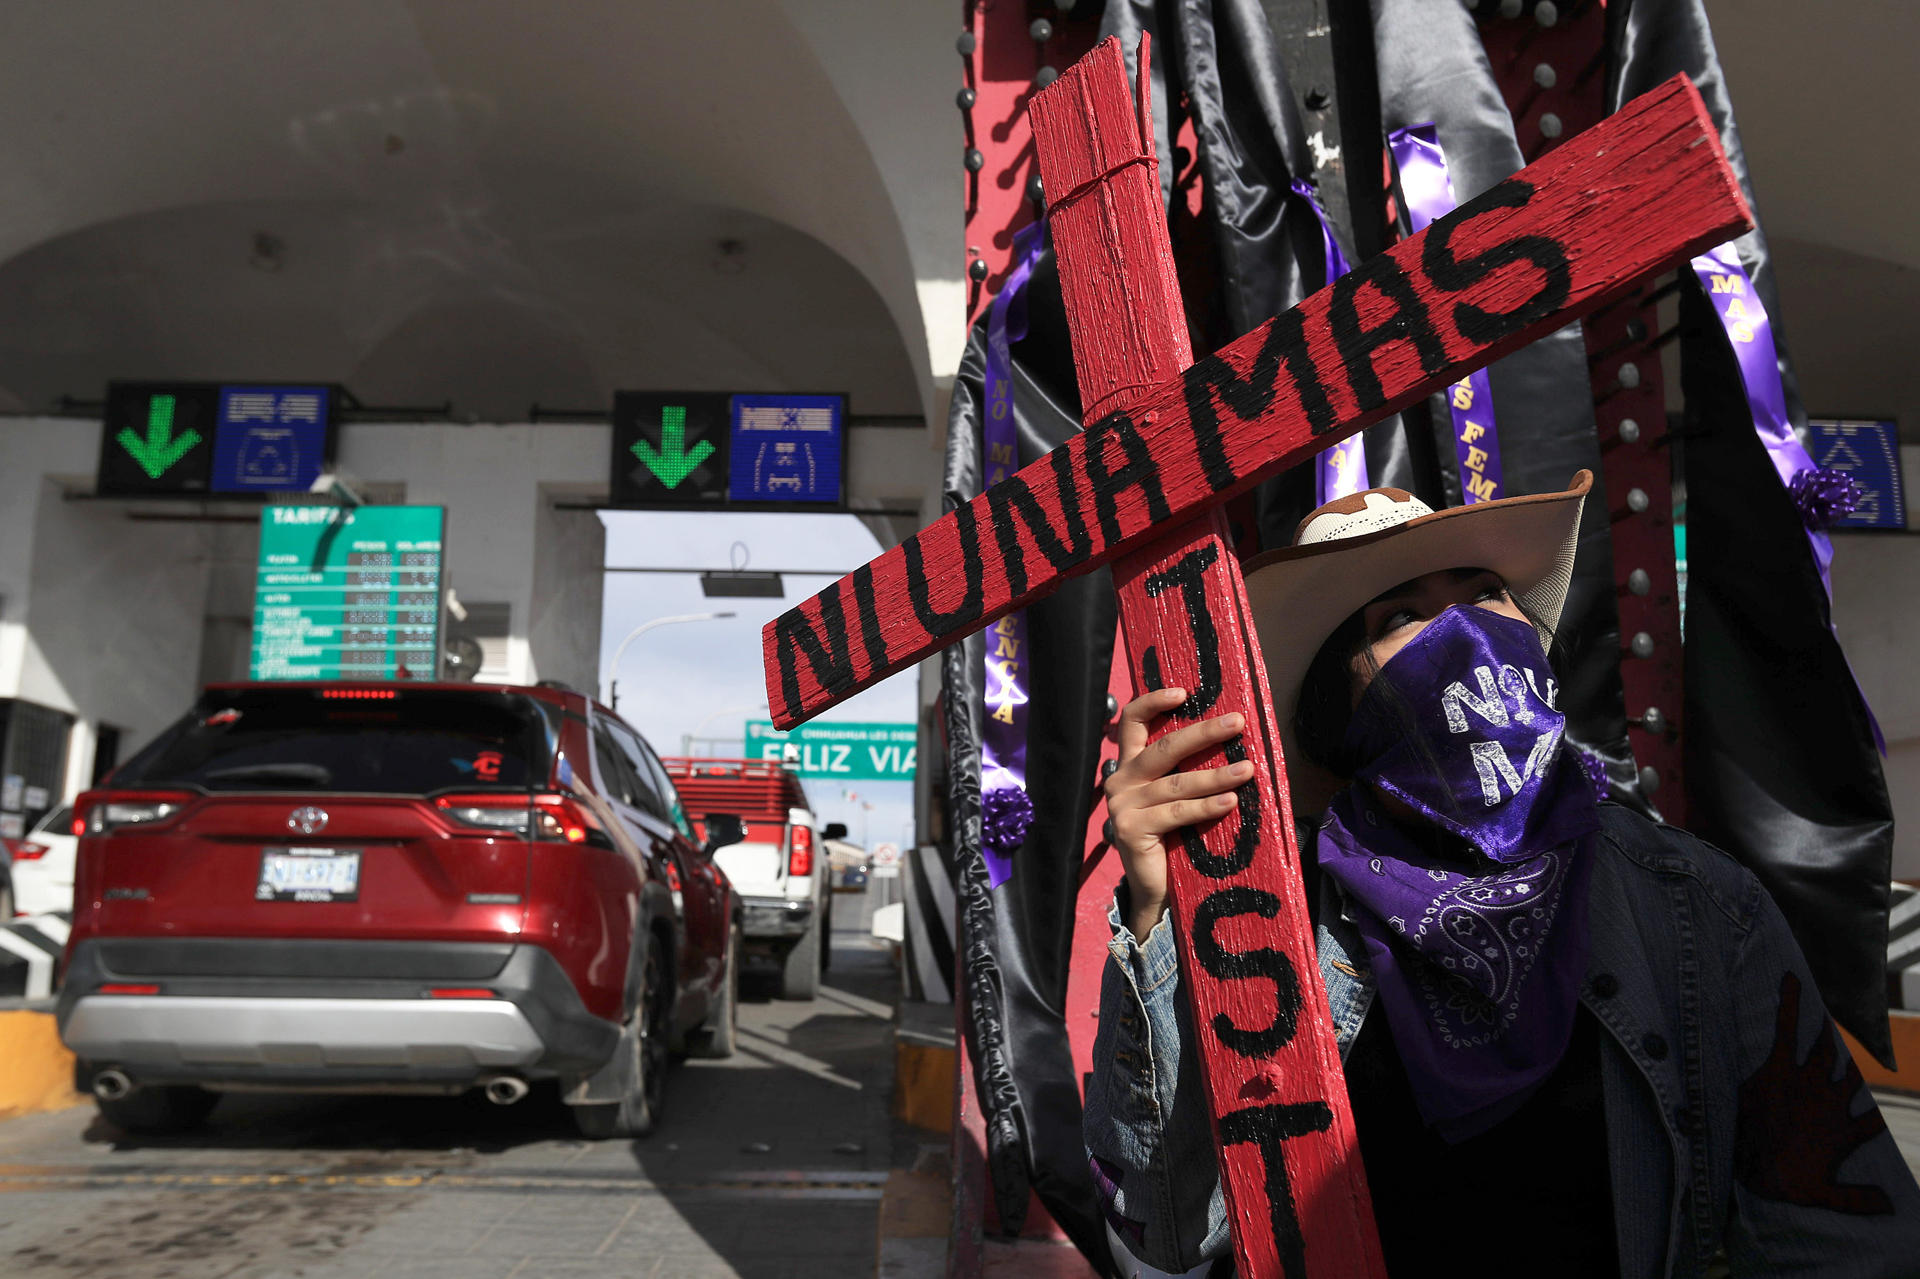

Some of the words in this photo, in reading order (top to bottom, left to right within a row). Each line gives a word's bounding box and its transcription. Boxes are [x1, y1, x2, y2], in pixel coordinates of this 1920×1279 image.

[1710, 274, 1754, 343] MAS
[991, 379, 1010, 421] NO
[774, 561, 890, 719] NI
[902, 410, 1173, 638] UNA
[1183, 178, 1572, 492] MAS
[1460, 420, 1498, 504] FEM
[762, 742, 852, 773] FELIZ
